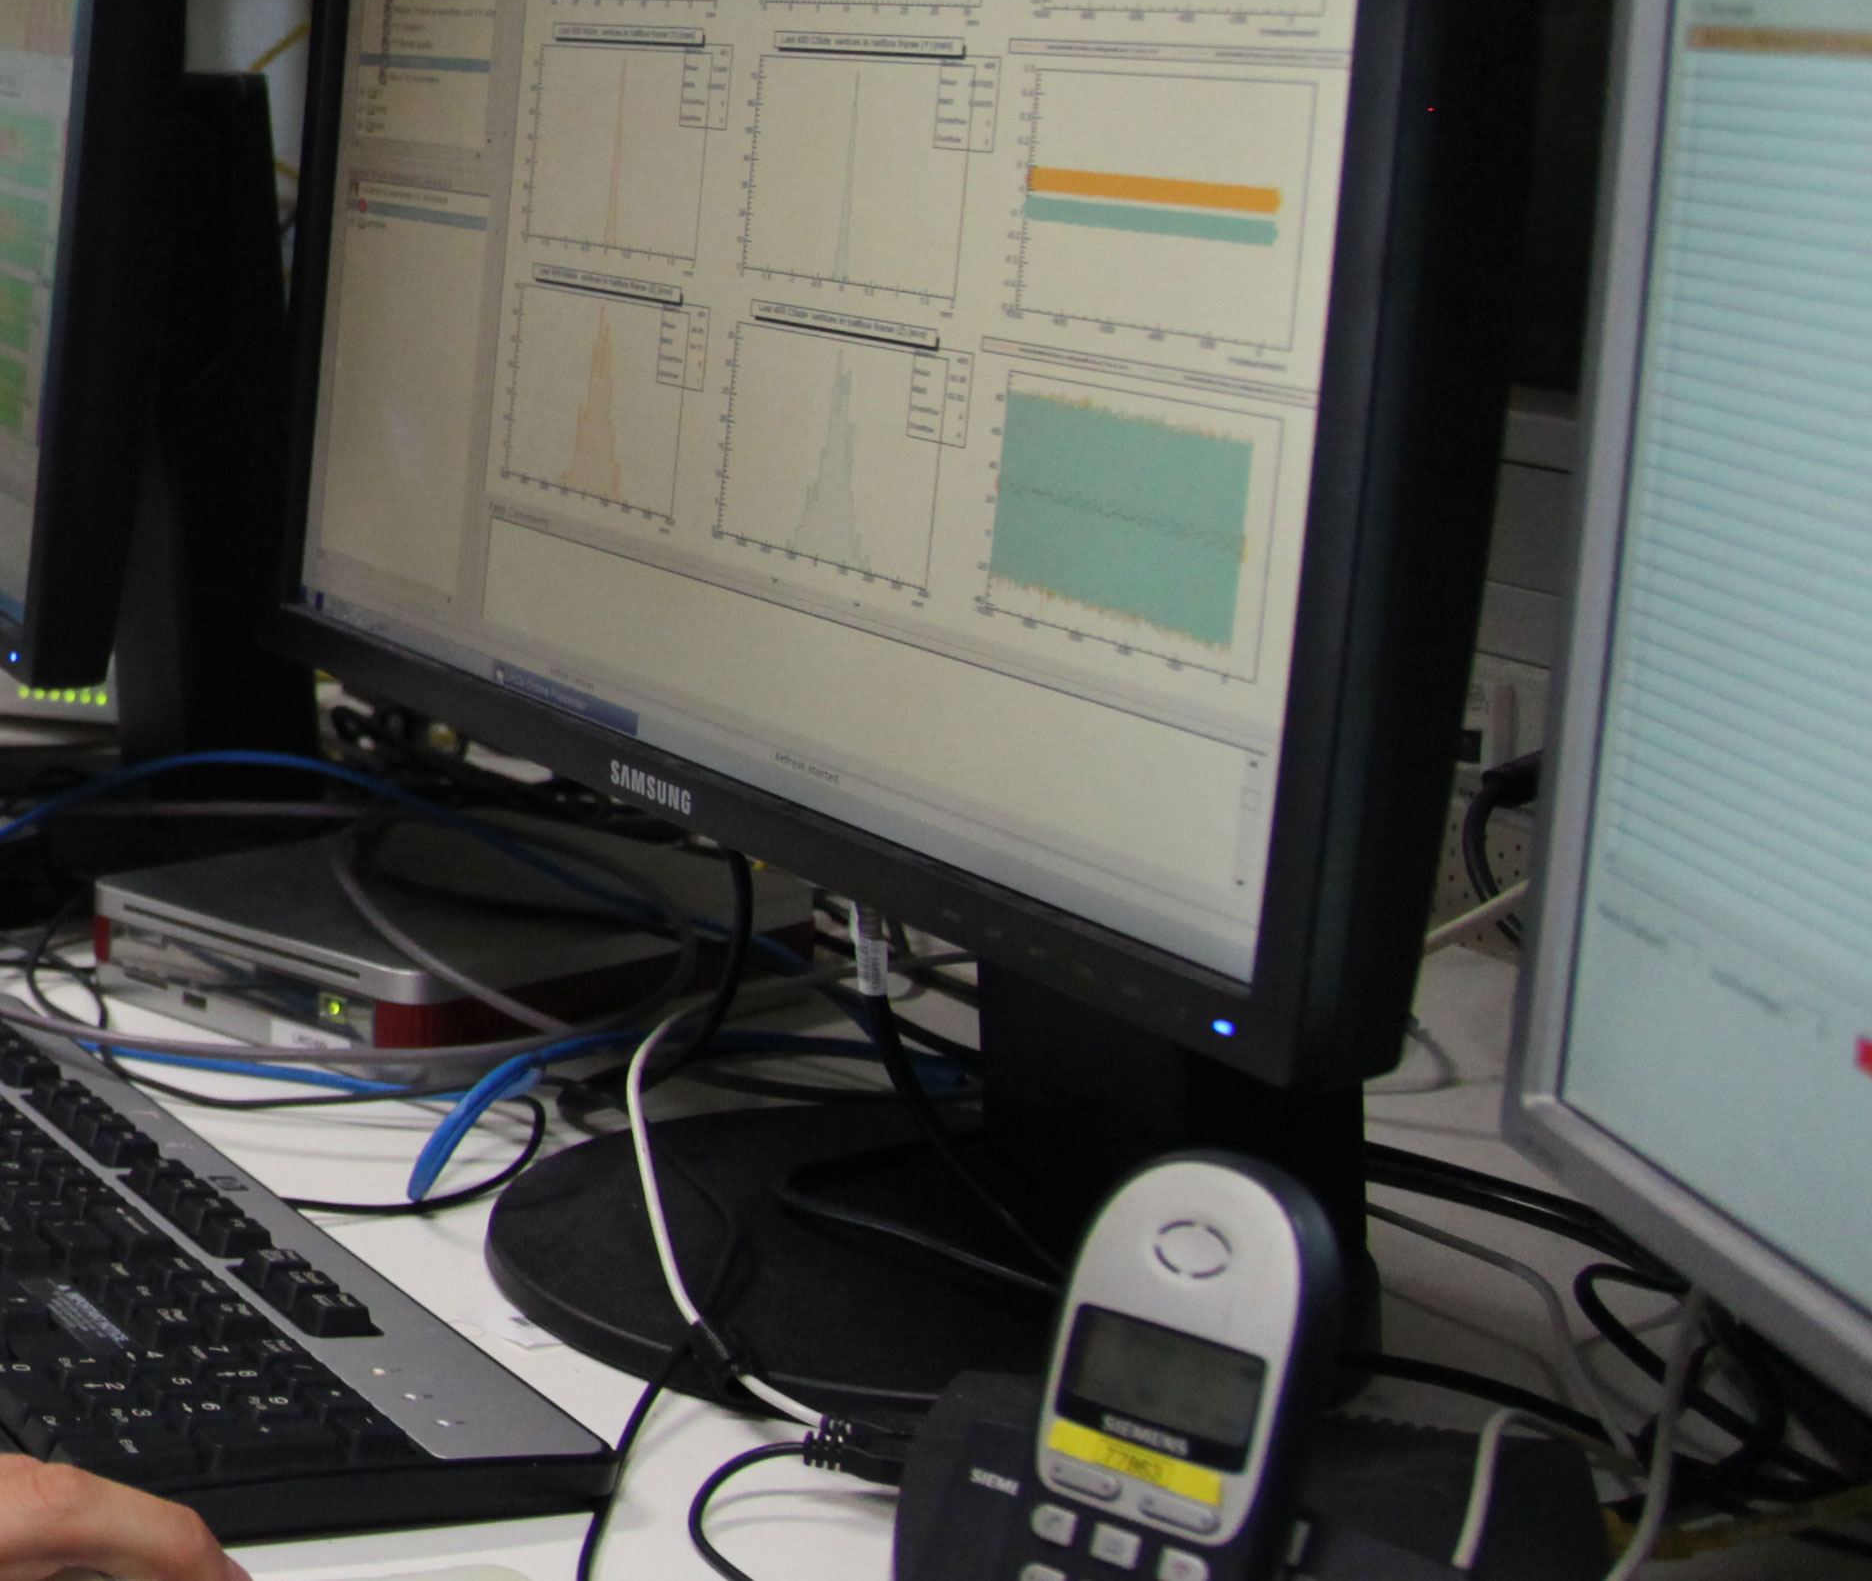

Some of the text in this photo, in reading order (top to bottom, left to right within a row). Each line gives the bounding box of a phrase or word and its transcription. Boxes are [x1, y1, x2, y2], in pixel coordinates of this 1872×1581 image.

[610, 759, 692, 815] SAMSUNG
[238, 1370, 259, 1378] 8
[172, 1377, 193, 1386] 5
[268, 1396, 289, 1406] 9
[201, 1402, 222, 1411] 6
[131, 1408, 153, 1418] 3
[1102, 1415, 1189, 1457] SIEMENS
